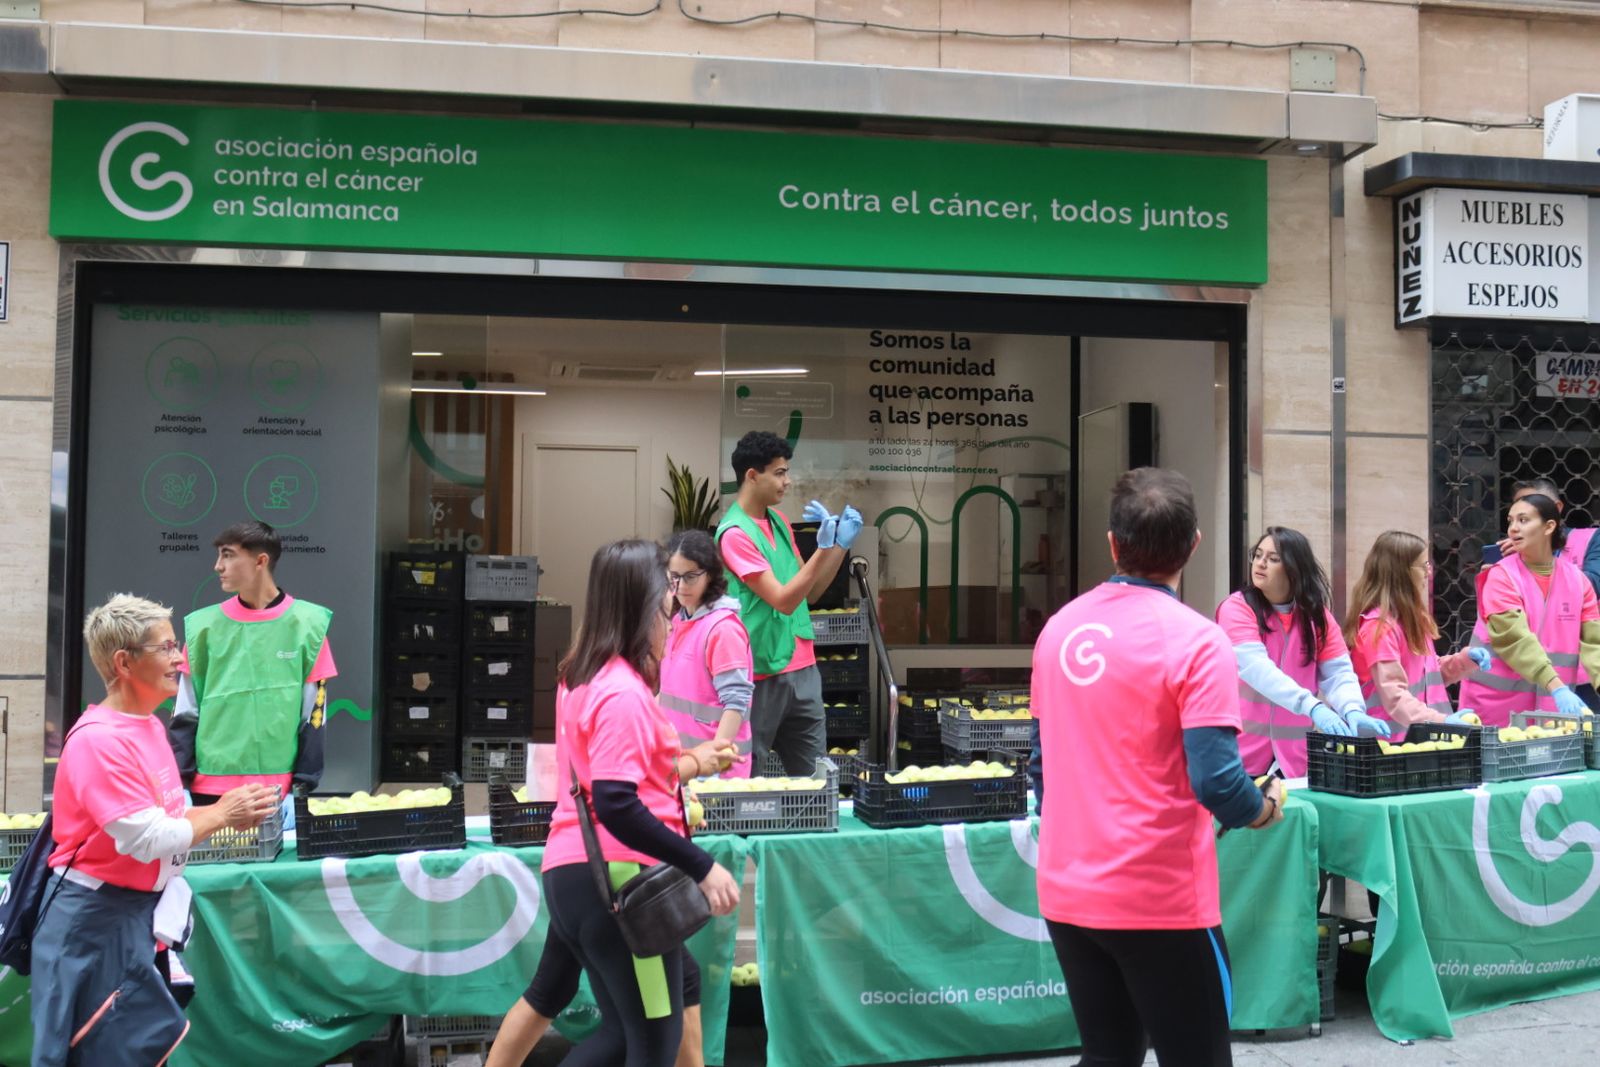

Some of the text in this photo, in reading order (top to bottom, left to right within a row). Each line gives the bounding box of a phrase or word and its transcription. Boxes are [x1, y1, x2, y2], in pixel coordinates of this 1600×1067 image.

[214, 136, 478, 168] asociación española
[213, 165, 424, 193] contra el cáncer
[212, 195, 400, 222] en Salamanca
[778, 184, 1229, 232] Contra el cáncer, todos juntos
[1460, 198, 1565, 228] MUEBLES
[1442, 240, 1584, 269] ACCESORIOS
[1467, 282, 1559, 310] ESPEJOS
[869, 329, 972, 351] Somos la
[869, 357, 996, 377] comunidad
[868, 383, 1035, 406] que acompaña
[300, 418, 305, 427] y
[869, 406, 1029, 430] a las personas
[295, 428, 322, 437] social
[868, 448, 885, 456] 900
[887, 448, 903, 456] 100
[161, 531, 199, 541] Talleres
[159, 543, 200, 553] grupales
[740, 800, 777, 812] MAC
[1472, 959, 1533, 980] española
[1536, 957, 1576, 974] contra
[859, 978, 1067, 1006] asociación española
